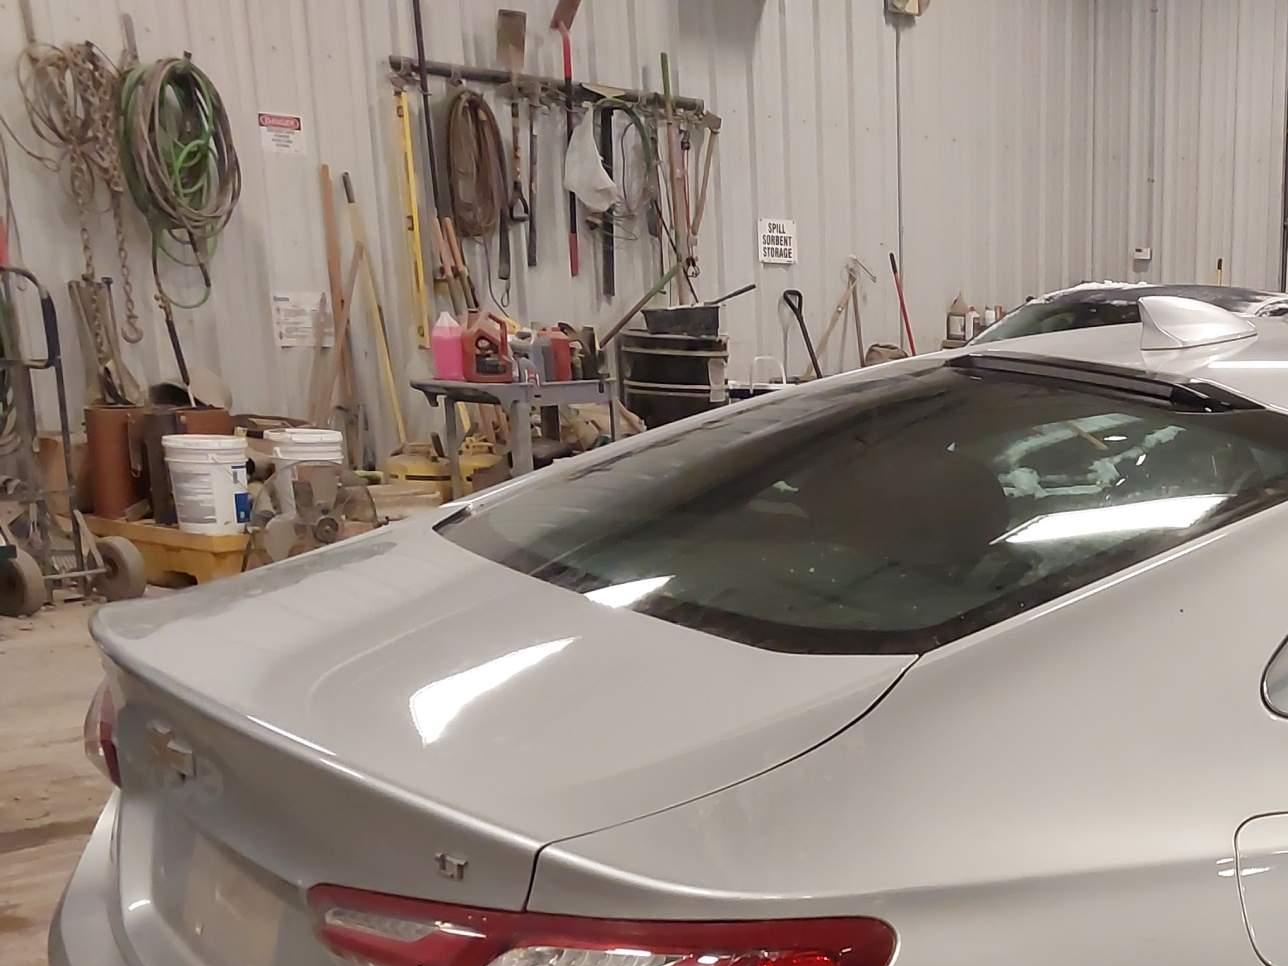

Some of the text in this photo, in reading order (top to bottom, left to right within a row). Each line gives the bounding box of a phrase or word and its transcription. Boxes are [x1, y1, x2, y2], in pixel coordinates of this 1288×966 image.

[768, 222, 786, 234] SPILL
[762, 234, 792, 247] SORBENT
[763, 246, 793, 259] STORAGE
